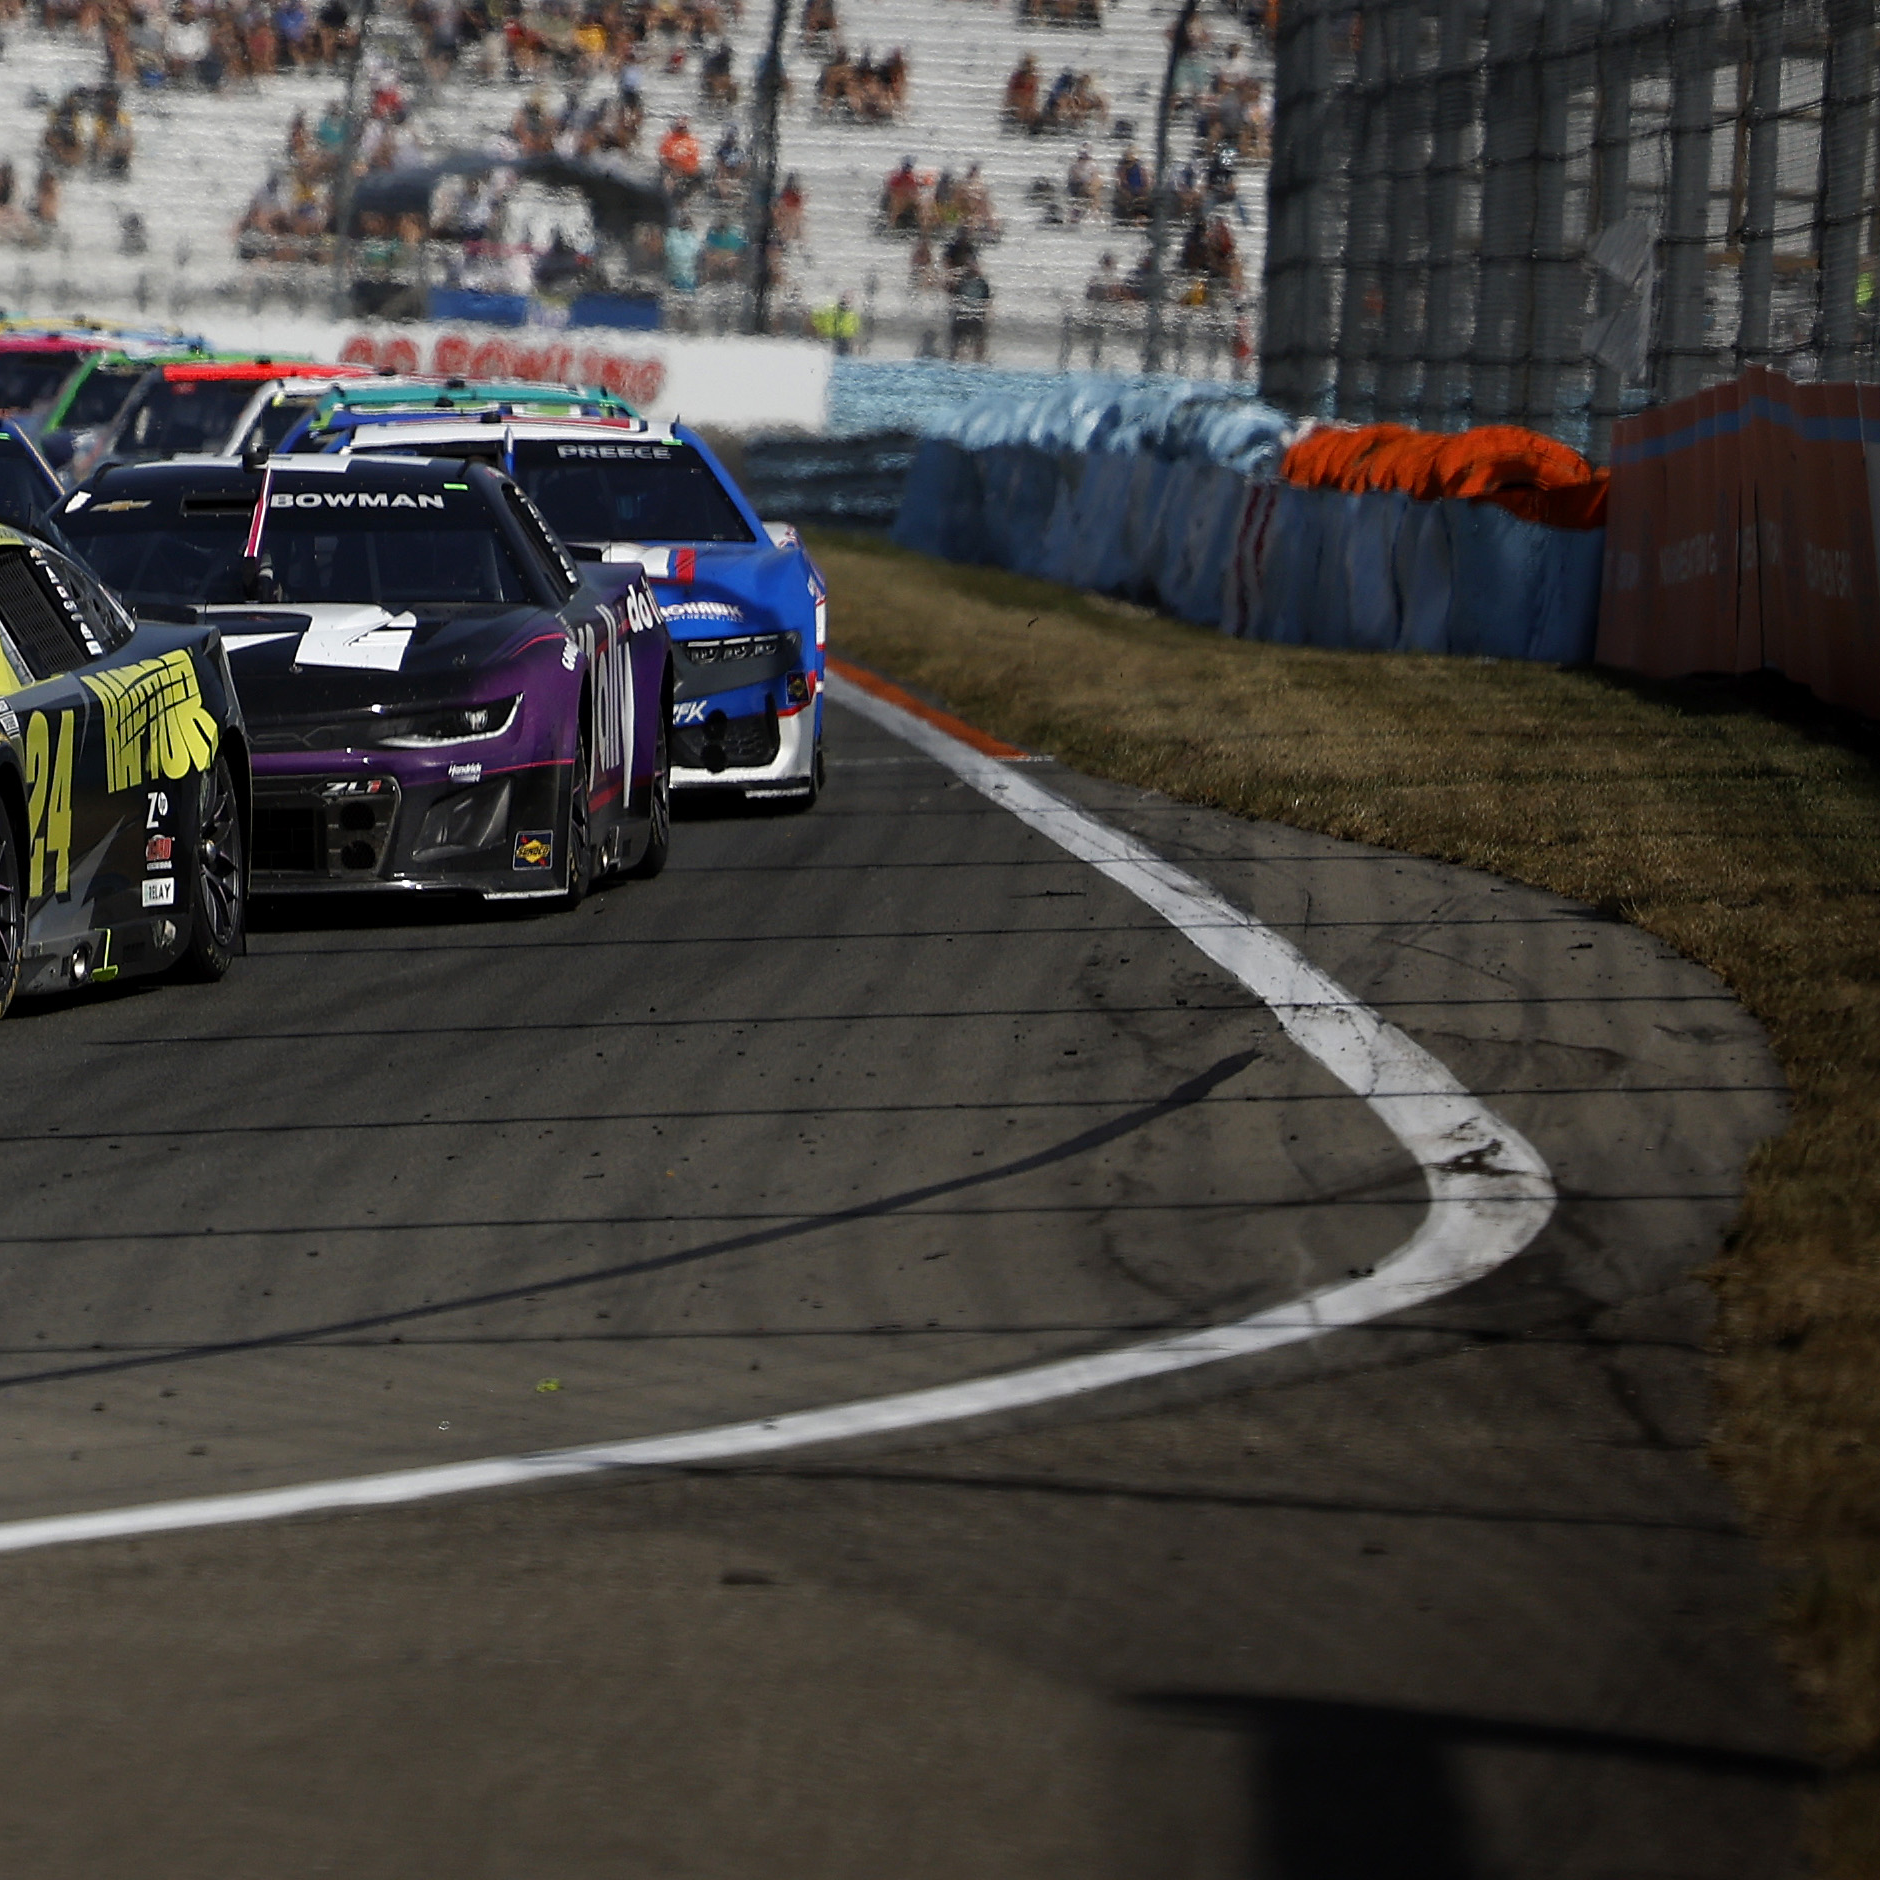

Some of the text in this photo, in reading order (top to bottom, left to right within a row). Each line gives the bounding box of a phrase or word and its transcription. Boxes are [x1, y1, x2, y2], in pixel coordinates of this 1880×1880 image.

[556, 445, 672, 460] PREECE
[270, 493, 445, 509] BOWMAN
[81, 649, 218, 793] RAPTOR
[26, 710, 75, 900] 24
